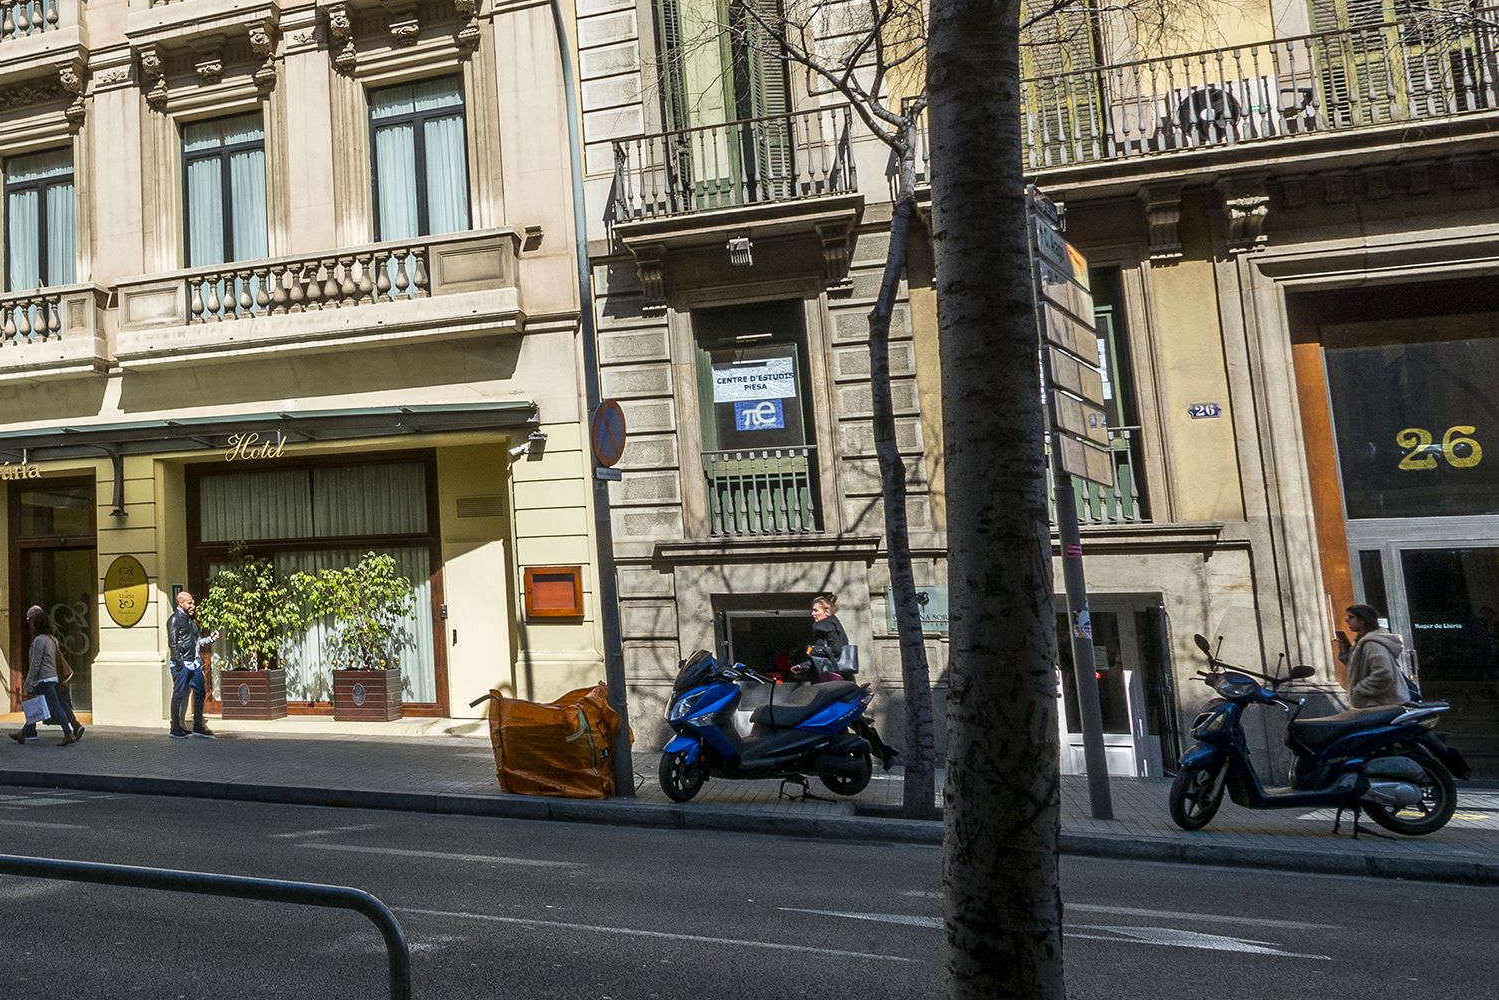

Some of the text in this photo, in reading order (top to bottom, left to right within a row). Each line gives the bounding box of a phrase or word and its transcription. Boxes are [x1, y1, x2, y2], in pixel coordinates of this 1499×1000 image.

[716, 372, 795, 385] CENTRE D'ESTUDIS
[1194, 405, 1215, 416] 26
[225, 432, 287, 462] Hotel
[1396, 425, 1483, 470] 26
